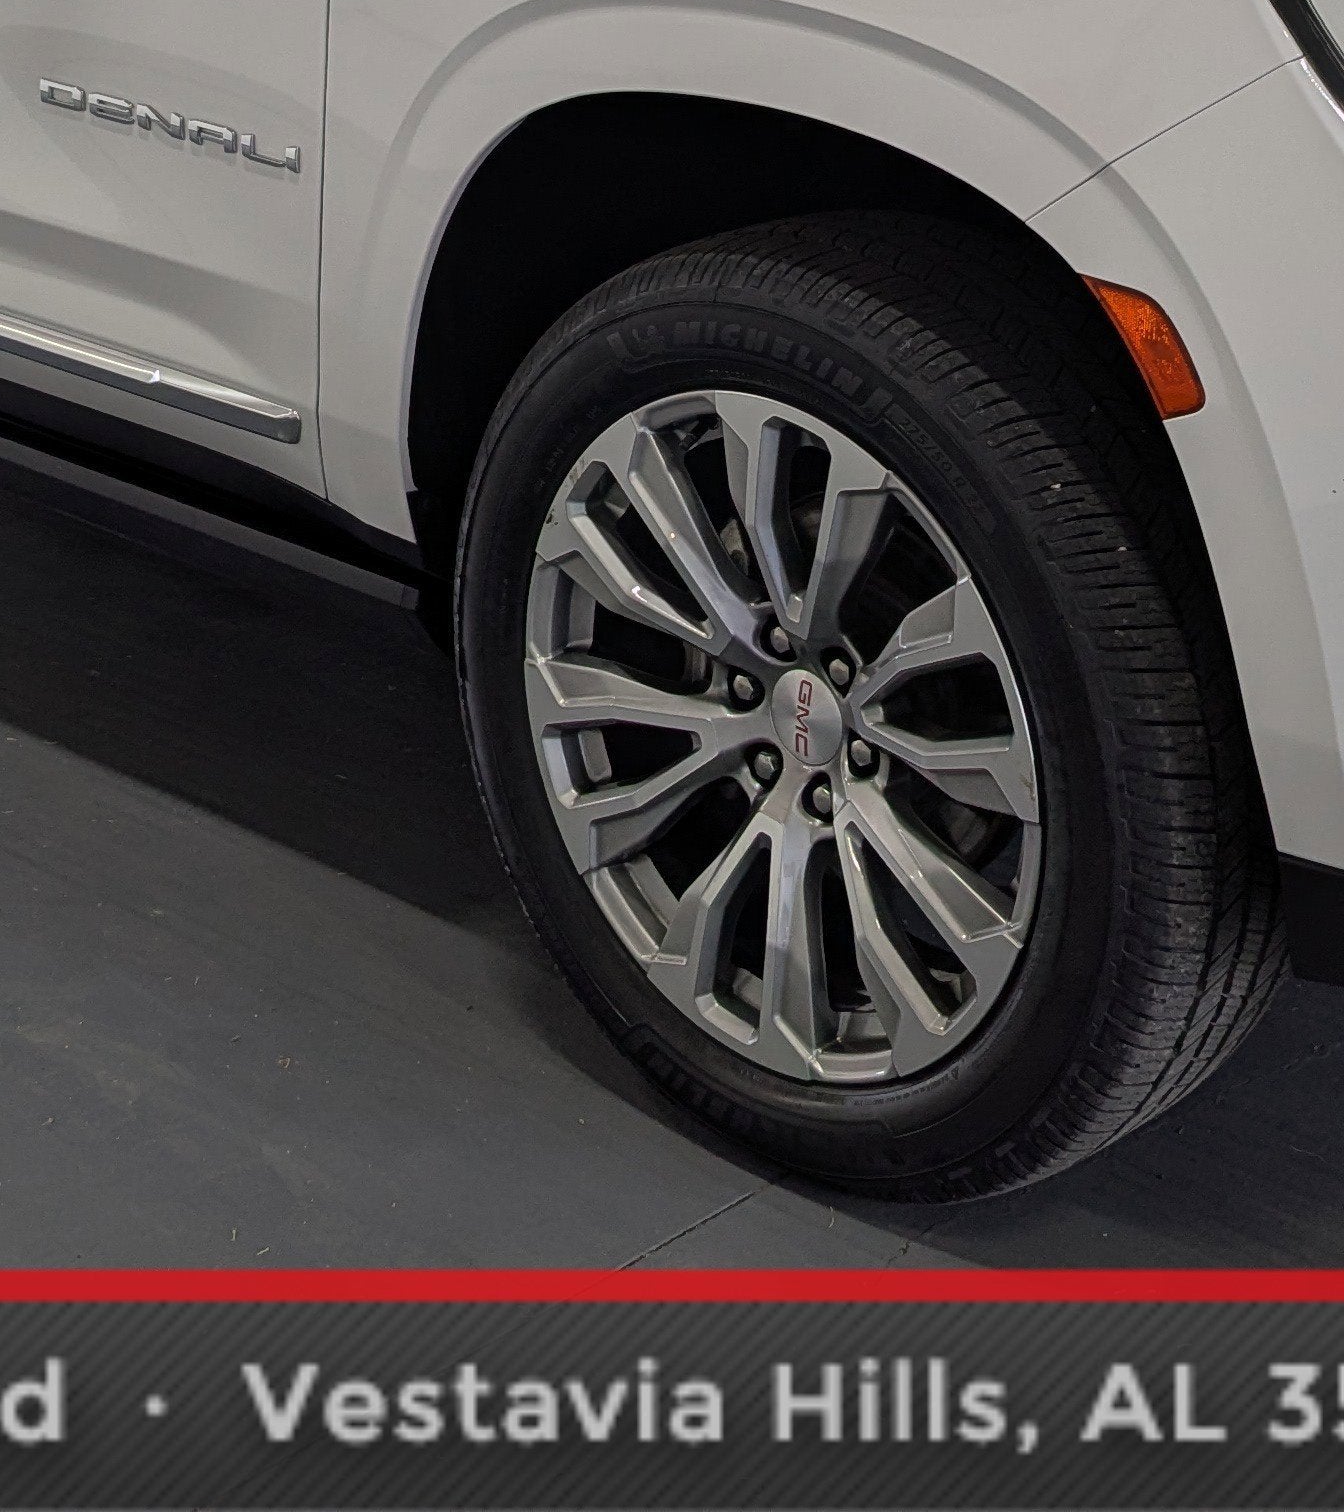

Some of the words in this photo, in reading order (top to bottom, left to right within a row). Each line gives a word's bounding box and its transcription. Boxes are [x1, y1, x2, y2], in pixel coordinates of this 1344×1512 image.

[40, 77, 302, 174] DENALI
[671, 320, 868, 400] MICHELIN
[794, 679, 813, 757] GMC
